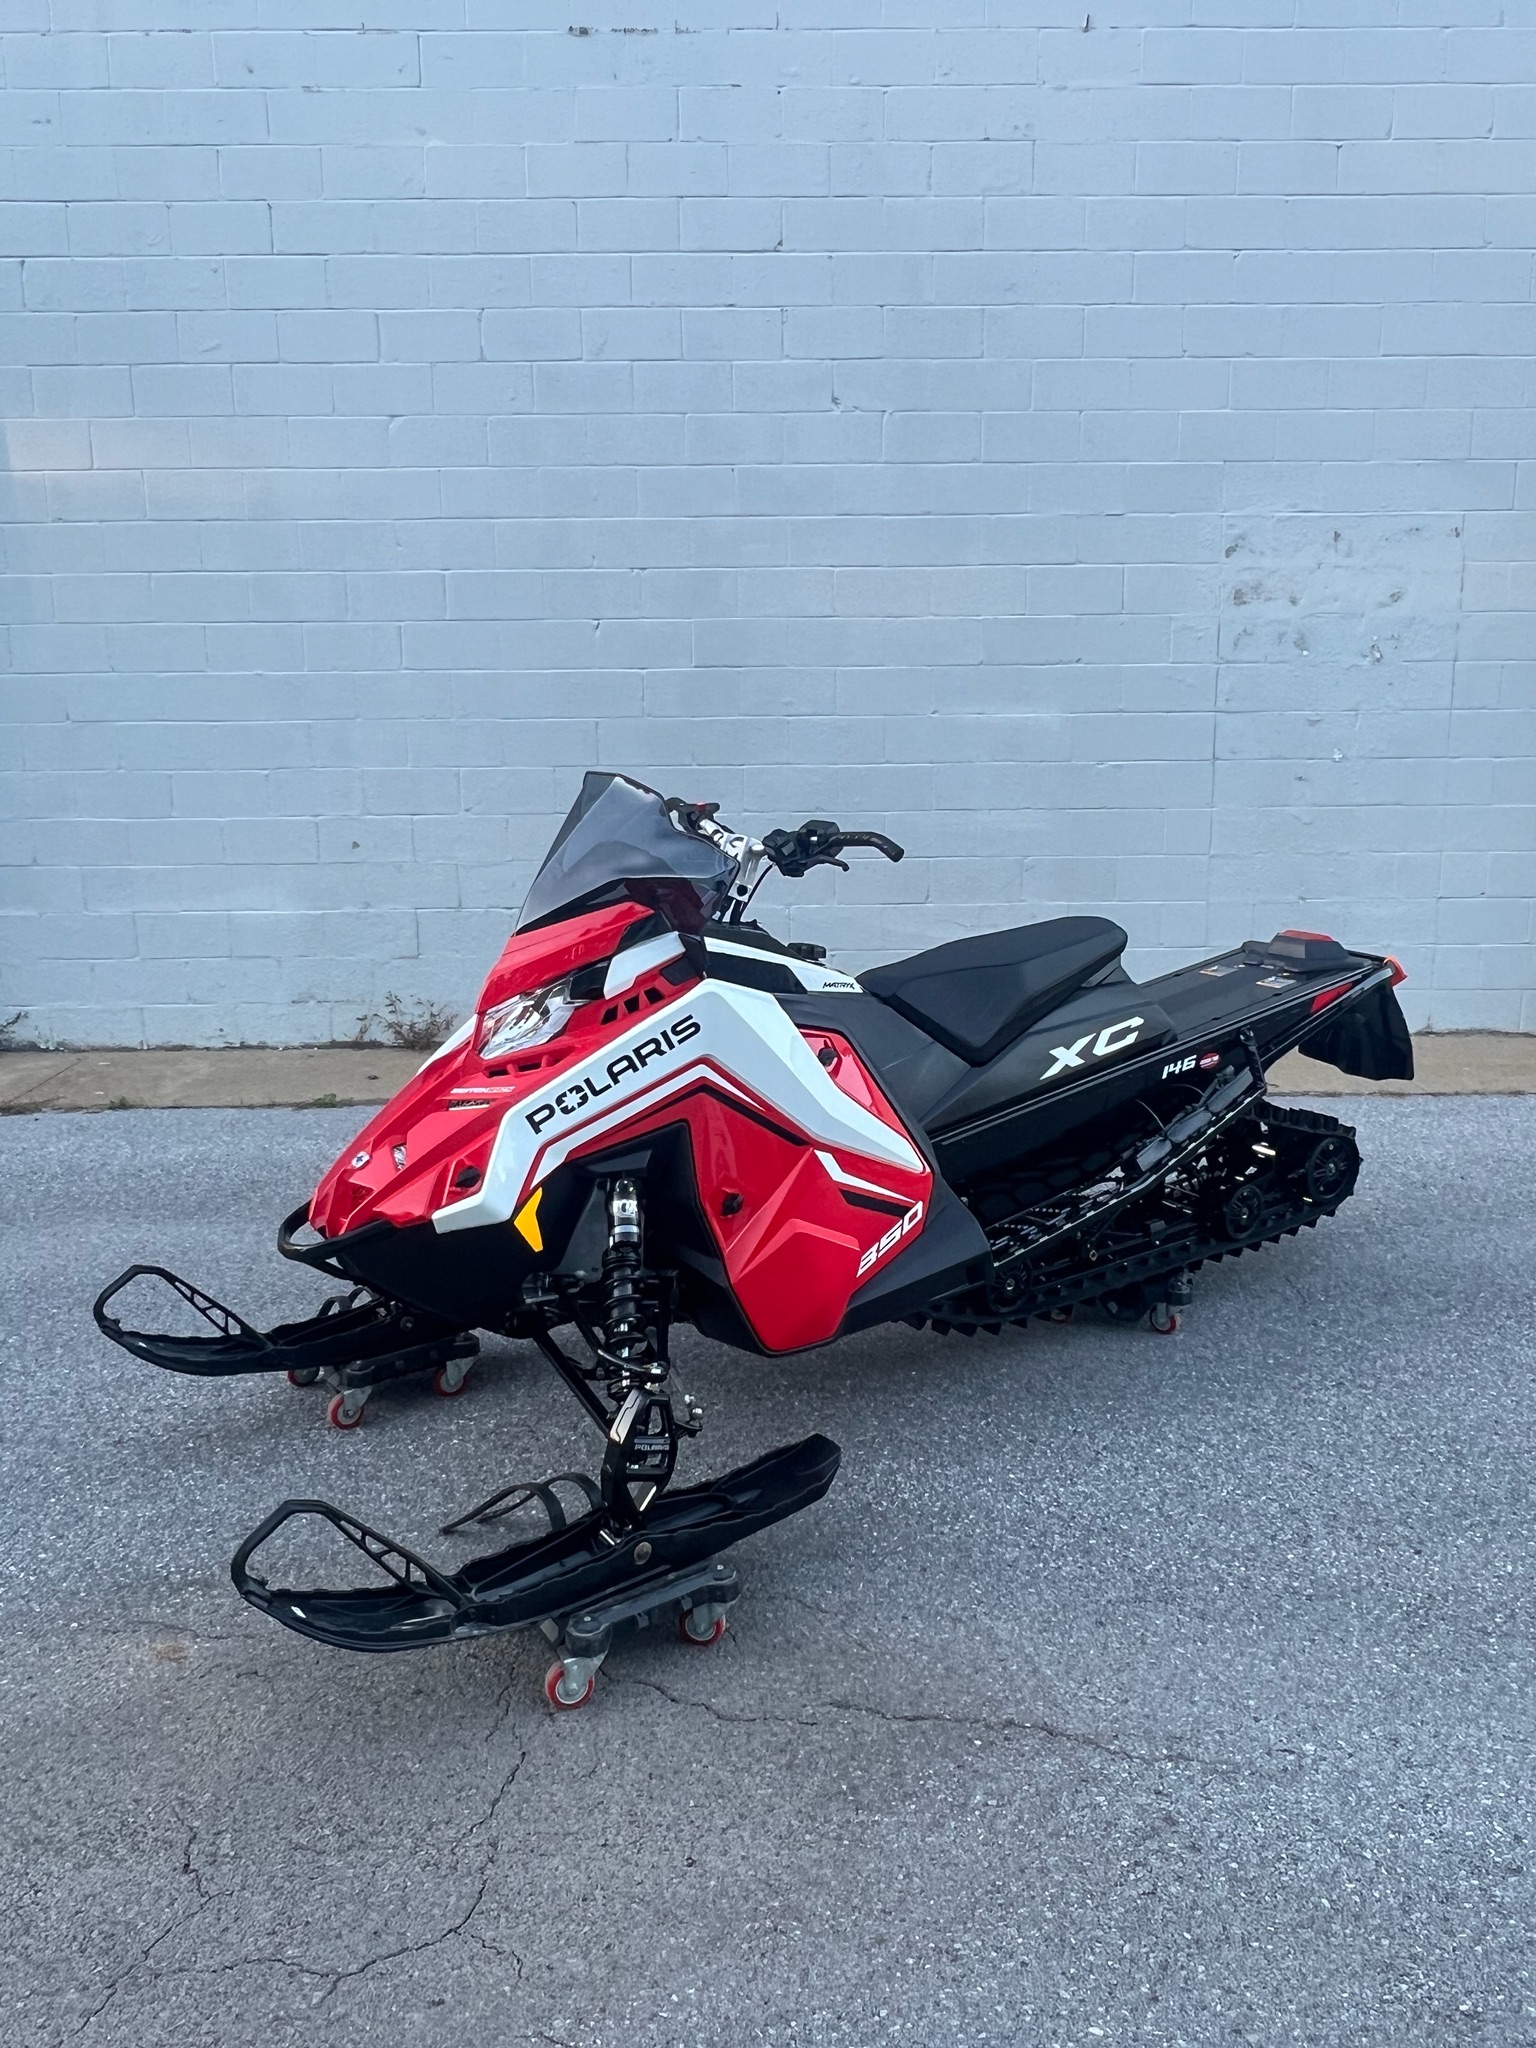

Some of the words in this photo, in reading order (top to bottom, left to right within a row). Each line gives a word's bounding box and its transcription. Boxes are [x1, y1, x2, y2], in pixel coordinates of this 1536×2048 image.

[525, 1014, 701, 1135] POLARIS
[1040, 1016, 1144, 1080] XC
[1161, 1054, 1197, 1079] 146
[856, 1200, 923, 1278] 850
